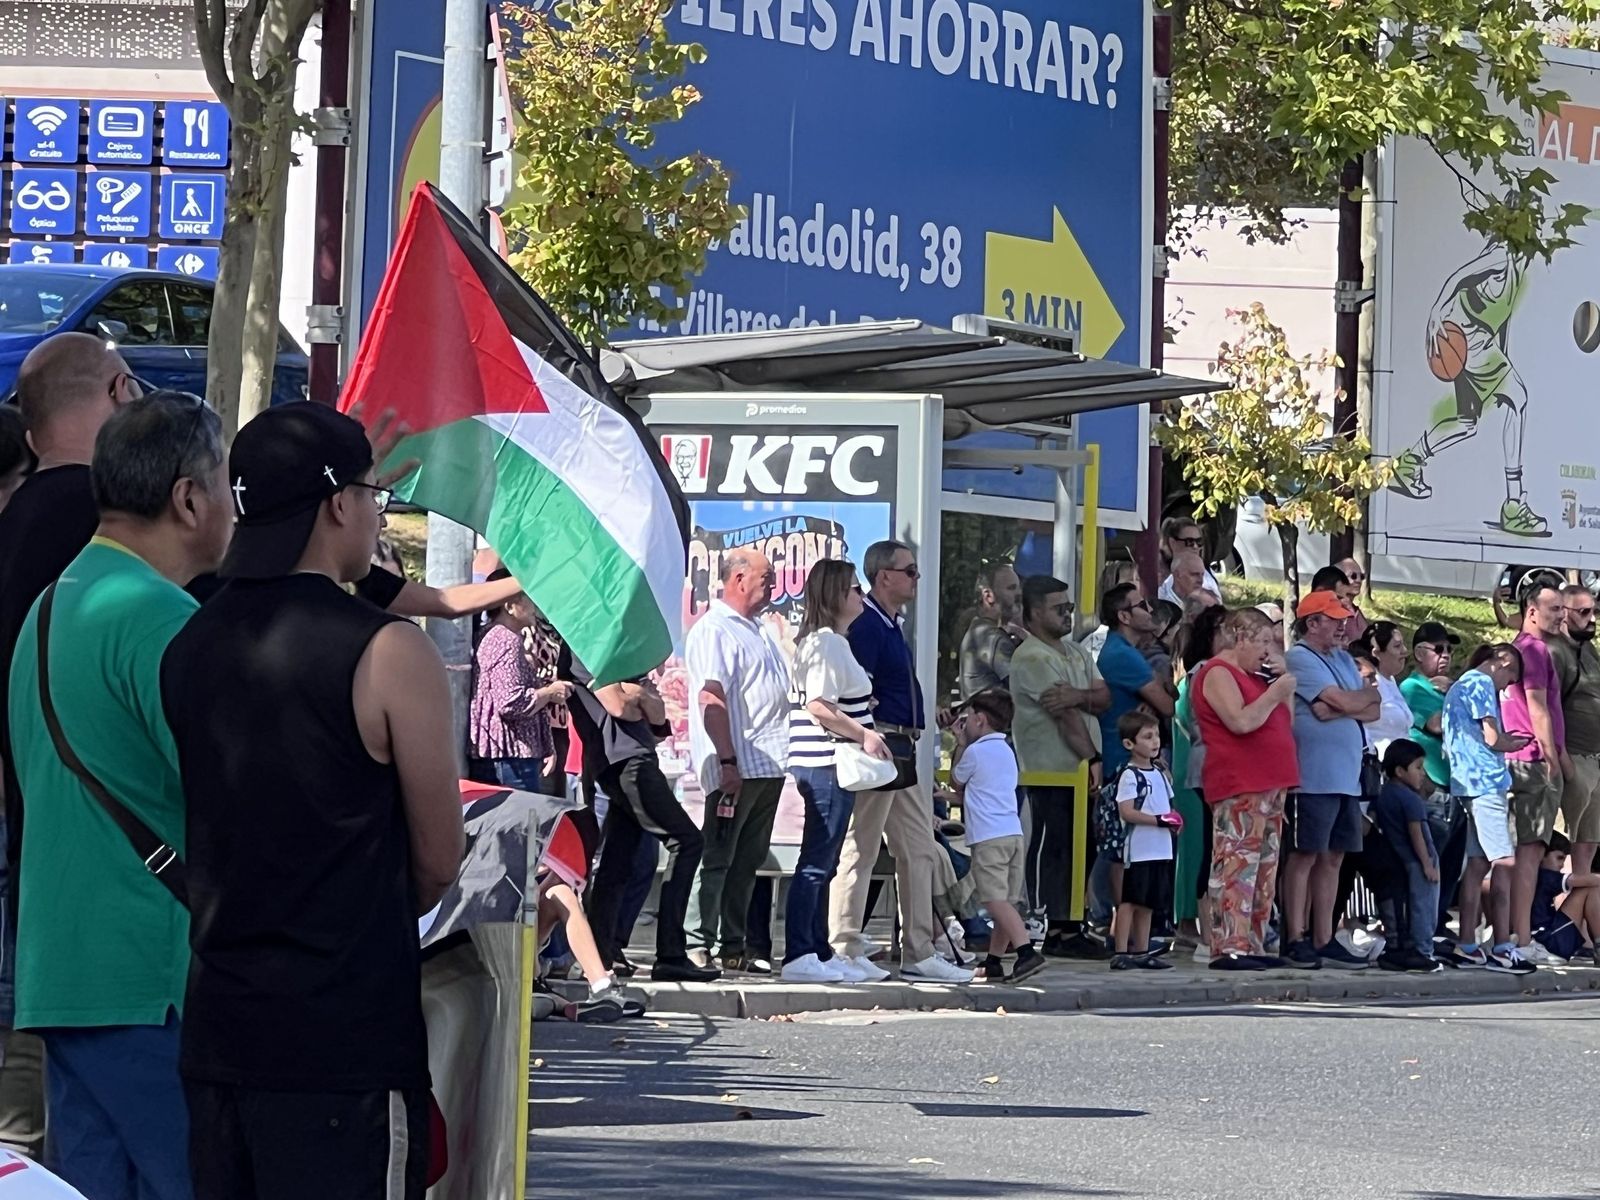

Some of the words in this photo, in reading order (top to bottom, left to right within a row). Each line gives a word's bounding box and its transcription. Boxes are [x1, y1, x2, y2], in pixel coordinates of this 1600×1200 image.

[849, 0, 1124, 109] AHORRAR?
[29, 149, 63, 158] Gratuito
[107, 142, 133, 151] Cajero
[169, 150, 221, 160] Restauración
[174, 224, 210, 234] ONCE
[708, 192, 910, 292] alladolid,
[920, 222, 962, 288] 38
[1001, 288, 1015, 321] 3
[1024, 292, 1082, 331] MIN
[759, 404, 807, 416] promedios
[717, 435, 886, 496] KFC
[723, 520, 783, 548] VUELVE
[785, 517, 808, 533] LA
